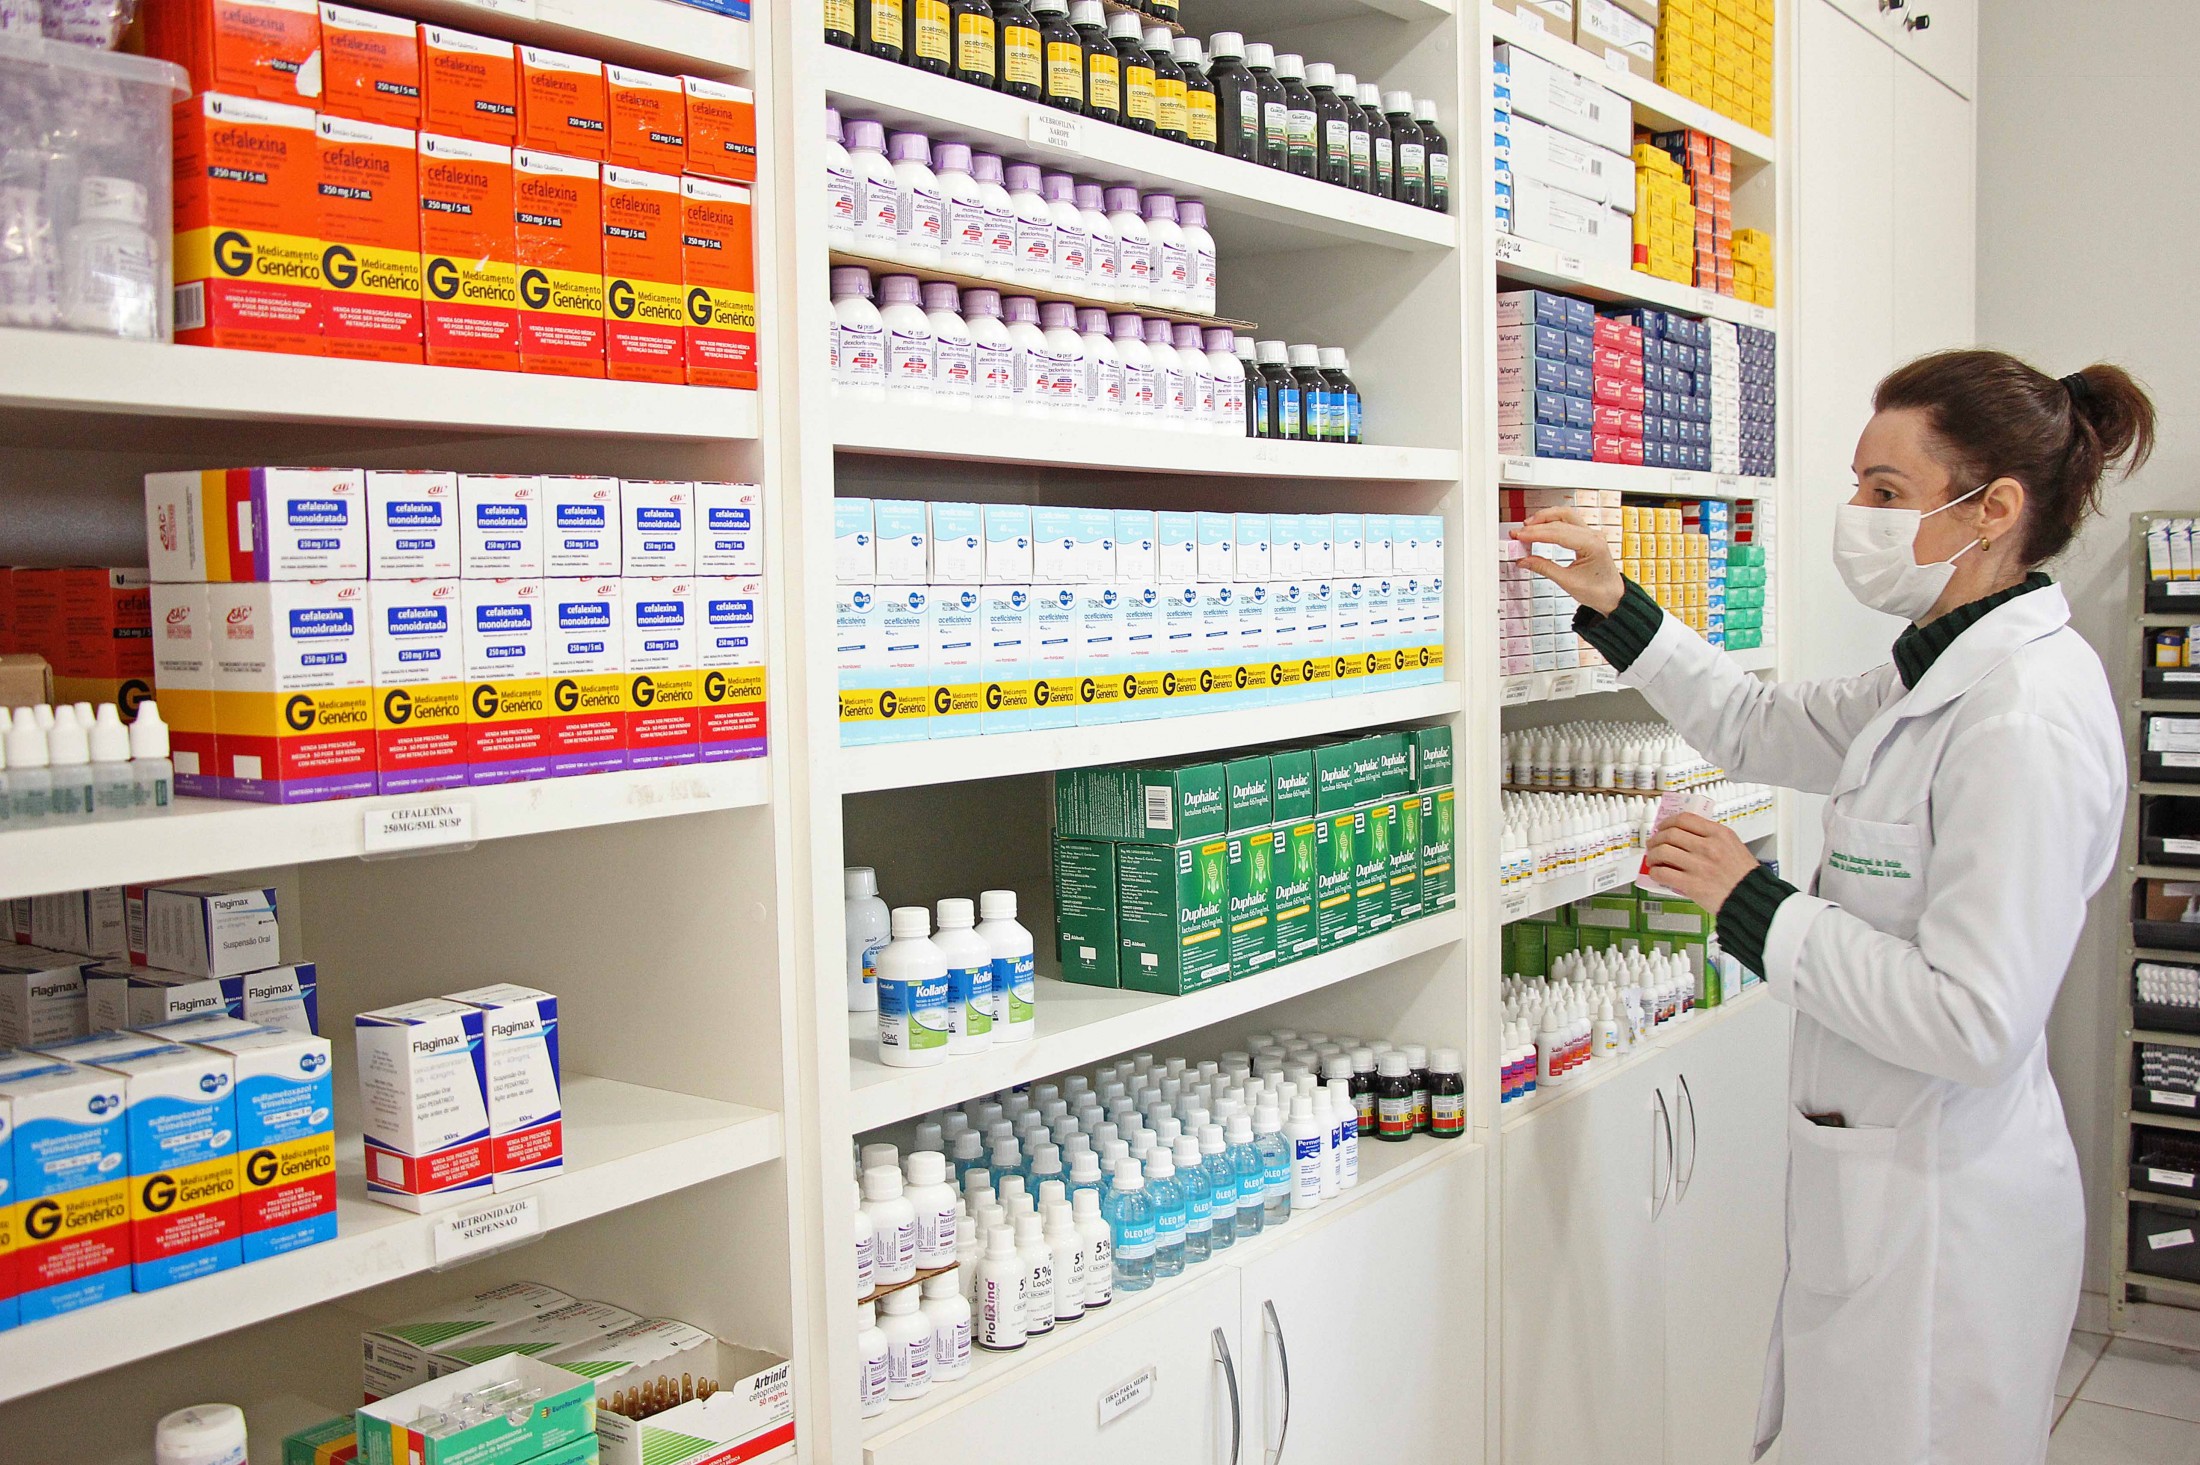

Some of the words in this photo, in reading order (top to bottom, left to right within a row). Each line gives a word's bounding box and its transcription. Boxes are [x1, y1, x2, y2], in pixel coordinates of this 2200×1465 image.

[331, 34, 386, 55] cefalexina
[434, 55, 486, 76] cefalexina
[531, 74, 577, 93] cefalexina
[616, 91, 659, 110] cefalexina
[692, 102, 733, 120] cefalexina
[1039, 115, 1075, 129] ACEBROFILINA
[1049, 127, 1070, 138] XAROPE
[213, 130, 287, 155] cefalexina
[1047, 136, 1068, 148] ADULTO
[323, 149, 390, 173] cefalexina
[427, 165, 489, 188] cefalexina
[521, 180, 577, 202] cefalexina
[610, 195, 661, 215] cefalexina
[687, 207, 734, 226] cefalexina
[214, 231, 254, 277] G
[257, 245, 319, 262] Medicamento
[256, 257, 320, 281] Genérico
[322, 245, 358, 289] G
[361, 259, 418, 274] Medicamento
[361, 270, 419, 292] Genérico
[427, 258, 460, 300] G
[463, 270, 515, 285] Medicamento
[462, 280, 515, 302] Genérico
[520, 269, 550, 310] G
[553, 280, 601, 296] Medicamento
[552, 291, 602, 312] Genérico
[609, 280, 635, 319] G
[637, 291, 682, 305] Medicamento
[687, 288, 712, 325] G
[714, 299, 754, 312] Medicamento
[637, 302, 682, 321] Genérico
[714, 310, 755, 327] Genérico
[297, 501, 338, 512] cefalexina
[395, 503, 433, 513] cefalexina
[485, 505, 519, 516] cefalexina
[564, 505, 597, 516] cefalexina
[643, 509, 674, 519] cefalexina
[716, 509, 744, 519] cefalexina
[290, 512, 347, 525] monoidratada
[389, 514, 441, 525] monoidratada
[478, 516, 526, 528] monoidratada
[558, 516, 603, 528] monoidratada
[638, 519, 680, 530] monoidratada
[710, 520, 749, 530] monoidratada
[301, 610, 343, 622] cefalexina
[398, 608, 438, 619] cefalexina
[486, 607, 523, 617] cefalexina
[567, 604, 602, 615] cefalexina
[644, 603, 677, 614] cefalexina
[716, 602, 747, 613] cefalexina
[390, 619, 446, 633] monoidratada
[478, 617, 531, 630] monoidratada
[560, 615, 609, 628] monoidratada
[638, 613, 683, 626] monoidratada
[710, 611, 752, 624] monoidratada
[292, 621, 353, 635] monoidratada
[581, 684, 619, 695] Medicamento
[657, 679, 692, 690] Medicamento
[704, 671, 726, 702] G
[728, 676, 761, 686] Medicamento
[501, 689, 542, 700] Medicamento
[554, 679, 579, 712] G
[581, 692, 620, 707] Genérico
[631, 675, 655, 707] G
[657, 687, 693, 702] Genérico
[728, 684, 762, 698] Genérico
[318, 699, 367, 713] Medicamento
[384, 689, 412, 725] G
[415, 694, 459, 709] Medicamento
[472, 684, 499, 718] G
[500, 697, 543, 713] Genérico
[898, 702, 926, 714] Genérico
[951, 698, 979, 710] Genérico
[285, 694, 316, 731] G
[318, 709, 367, 725] Genérico
[414, 703, 460, 719] Genérico
[1381, 754, 1406, 768] Duphalac
[1423, 748, 1448, 761] Duphalac
[1277, 773, 1308, 790] Duphalac
[1321, 767, 1350, 783] Duphalac
[1184, 787, 1219, 806] Duphalac
[1233, 780, 1267, 798] Duphalac
[391, 806, 454, 820] CEFALEXINA
[383, 819, 437, 834] 250MG/5ML
[439, 817, 462, 830] SUSP
[1423, 842, 1449, 856] Duphalac
[1356, 858, 1385, 877] Duphalac
[1319, 870, 1349, 889] Duphalac
[1275, 879, 1309, 900] Duphalac
[214, 898, 249, 910] Flagimax
[1231, 889, 1267, 911] Duphalac
[1181, 900, 1220, 923] Duphalac
[223, 938, 257, 950] Suspensão
[258, 934, 271, 944] Oral
[31, 981, 79, 998] Flagimax
[249, 982, 294, 999] Flagimax
[170, 996, 218, 1012] Flagimax
[491, 1018, 535, 1037] Flagimax
[413, 1034, 460, 1054] Flagimax
[281, 1144, 330, 1162] Medicamento
[247, 1149, 278, 1186] G
[281, 1154, 331, 1176] Genérico
[180, 1167, 233, 1187] Medicamento
[143, 1174, 177, 1212] G
[180, 1178, 234, 1202] Genérico
[66, 1192, 124, 1212] Medicamento
[25, 1199, 62, 1239] G
[65, 1203, 125, 1229] Genérico
[451, 1201, 529, 1231] METRONIDAZOL
[464, 1217, 518, 1240] SUSPENSAO
[754, 1366, 788, 1392] Artrinid
[1119, 1383, 1133, 1396] PARA
[1133, 1373, 1149, 1386] MEDIR
[749, 1380, 789, 1402] cetoprofeno
[758, 1397, 767, 1407] 50
[767, 1391, 788, 1406] mg/mL
[1115, 1389, 1140, 1406] GLICEMIA
[551, 1396, 581, 1414] Eurofarma
